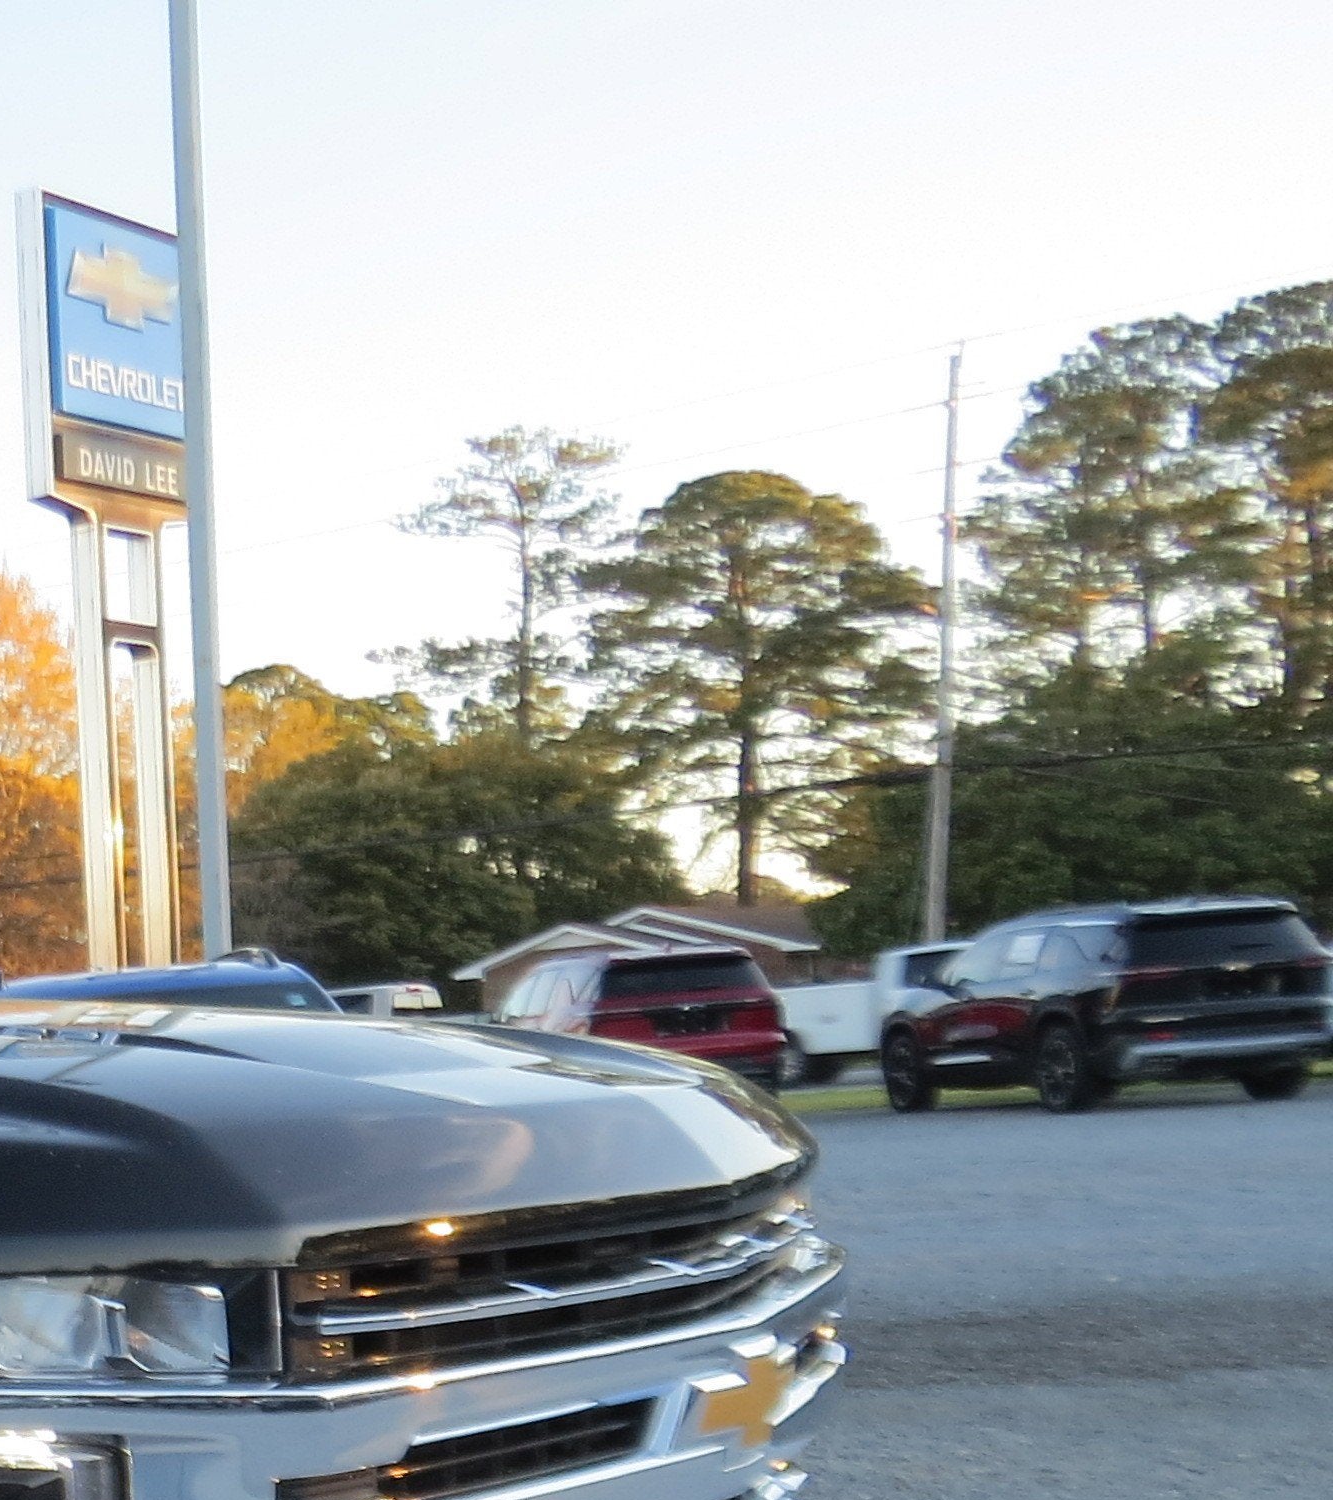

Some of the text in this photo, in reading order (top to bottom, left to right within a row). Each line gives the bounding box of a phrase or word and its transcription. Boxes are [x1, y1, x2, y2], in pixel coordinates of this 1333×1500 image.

[66, 353, 184, 413] CHEVROLET
[79, 446, 180, 496] DAVID LEE
